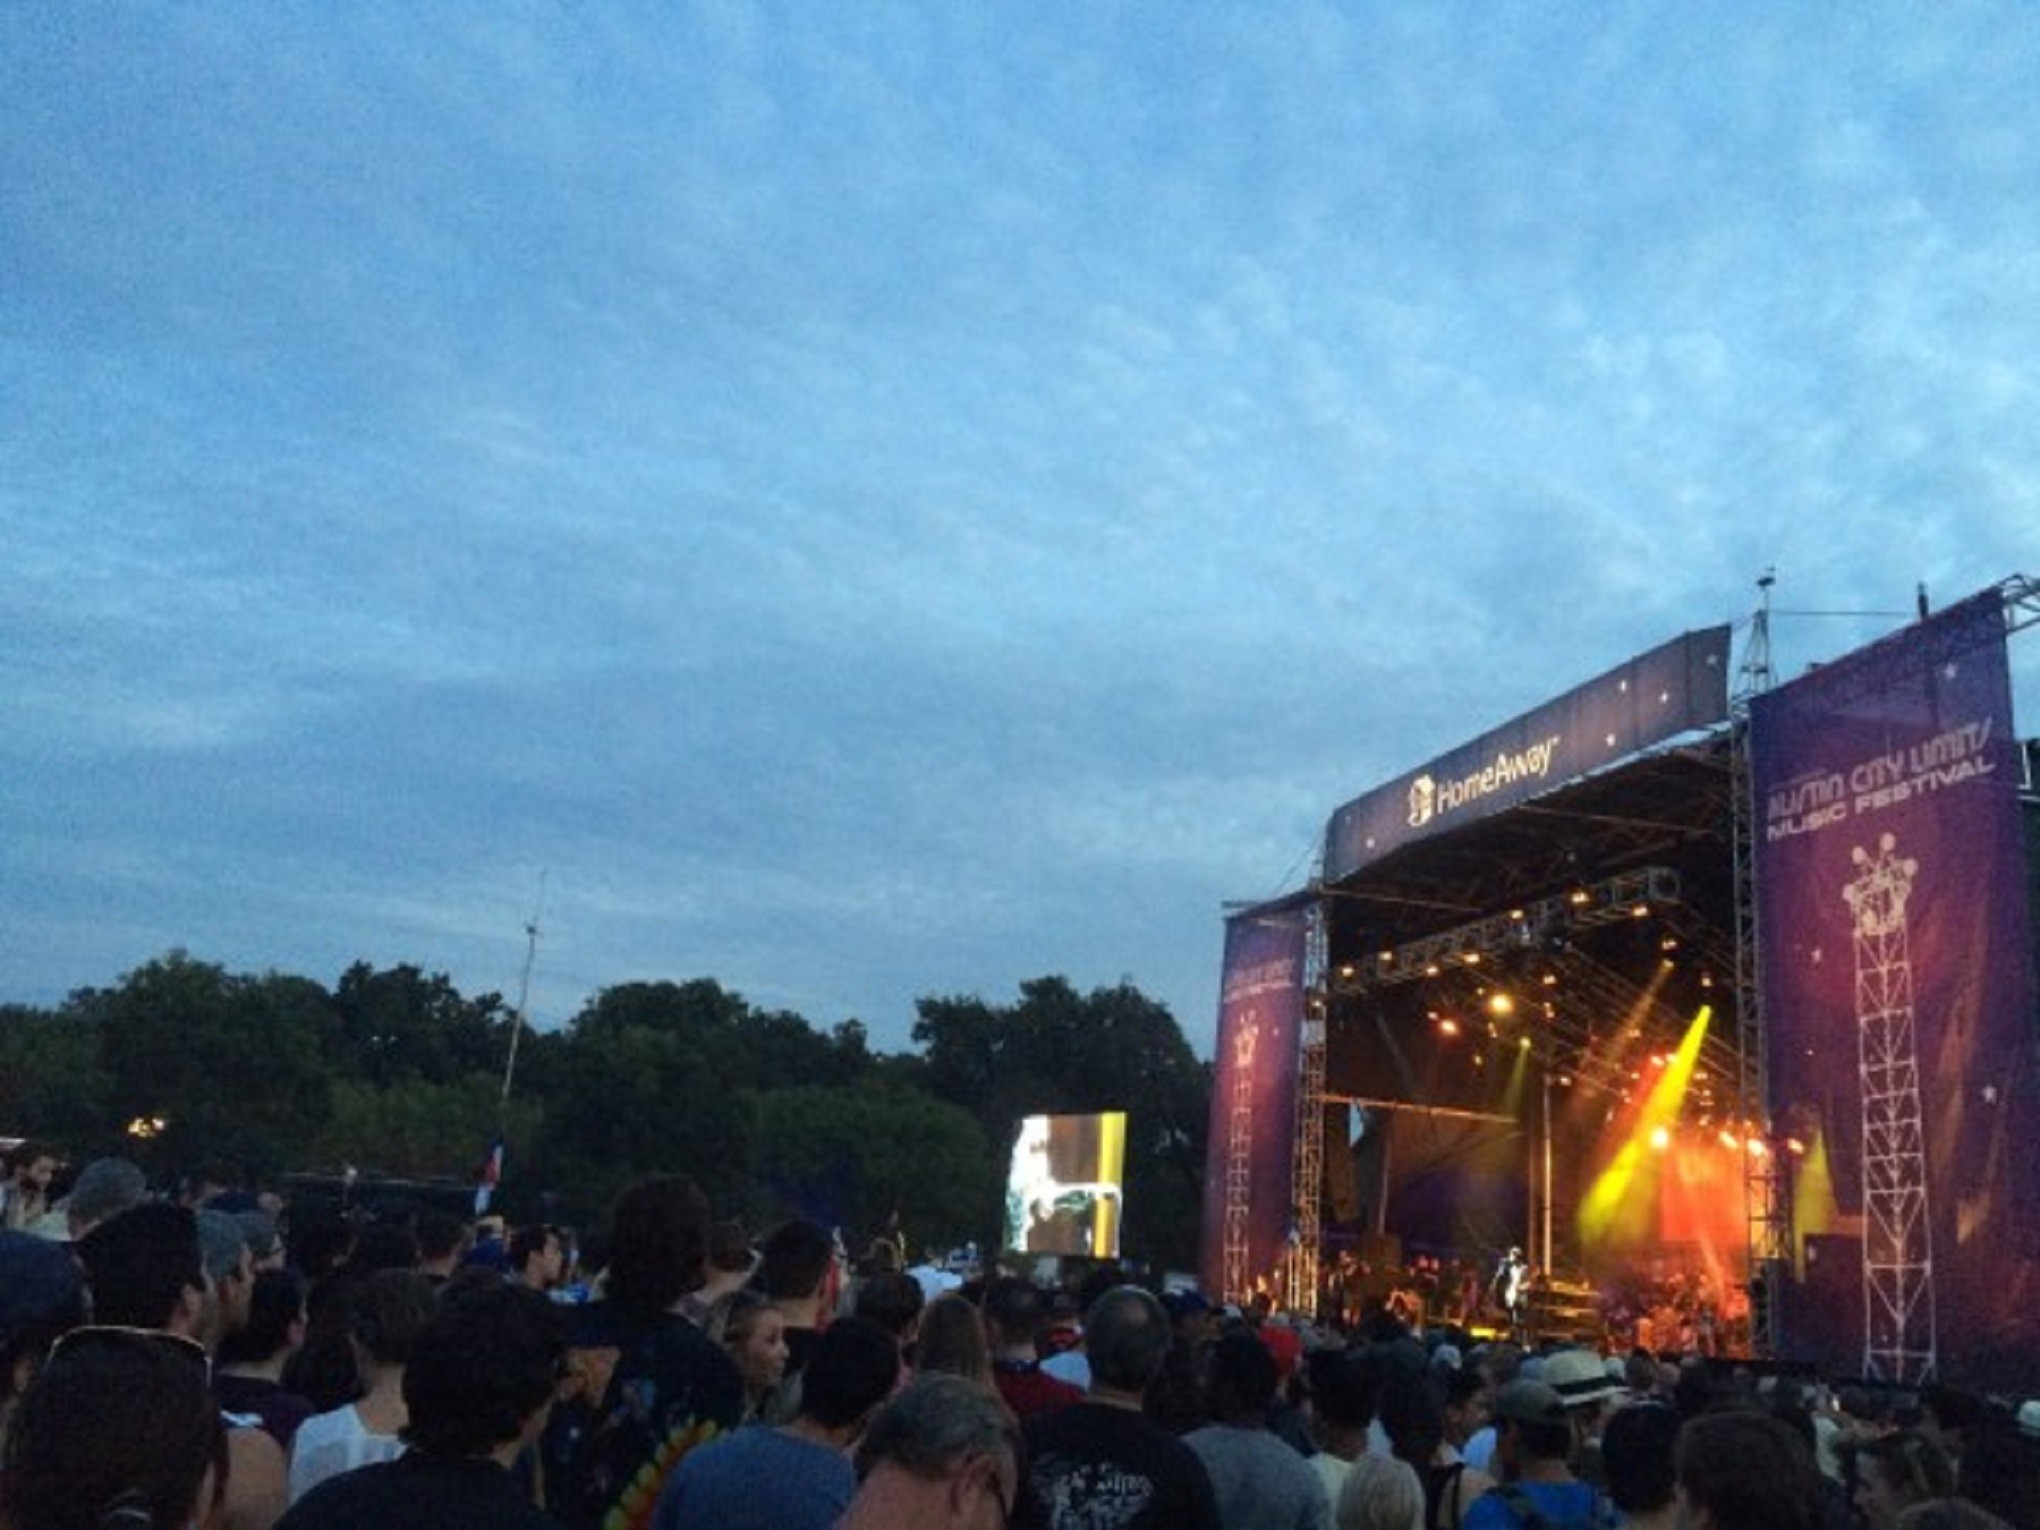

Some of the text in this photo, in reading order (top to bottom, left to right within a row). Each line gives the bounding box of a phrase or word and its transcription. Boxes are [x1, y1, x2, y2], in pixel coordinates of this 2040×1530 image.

[1436, 738, 1554, 815] HomeAway
[1767, 755, 1997, 842] MUSIC FESTIVAL
[1851, 747, 1904, 793] CITY
